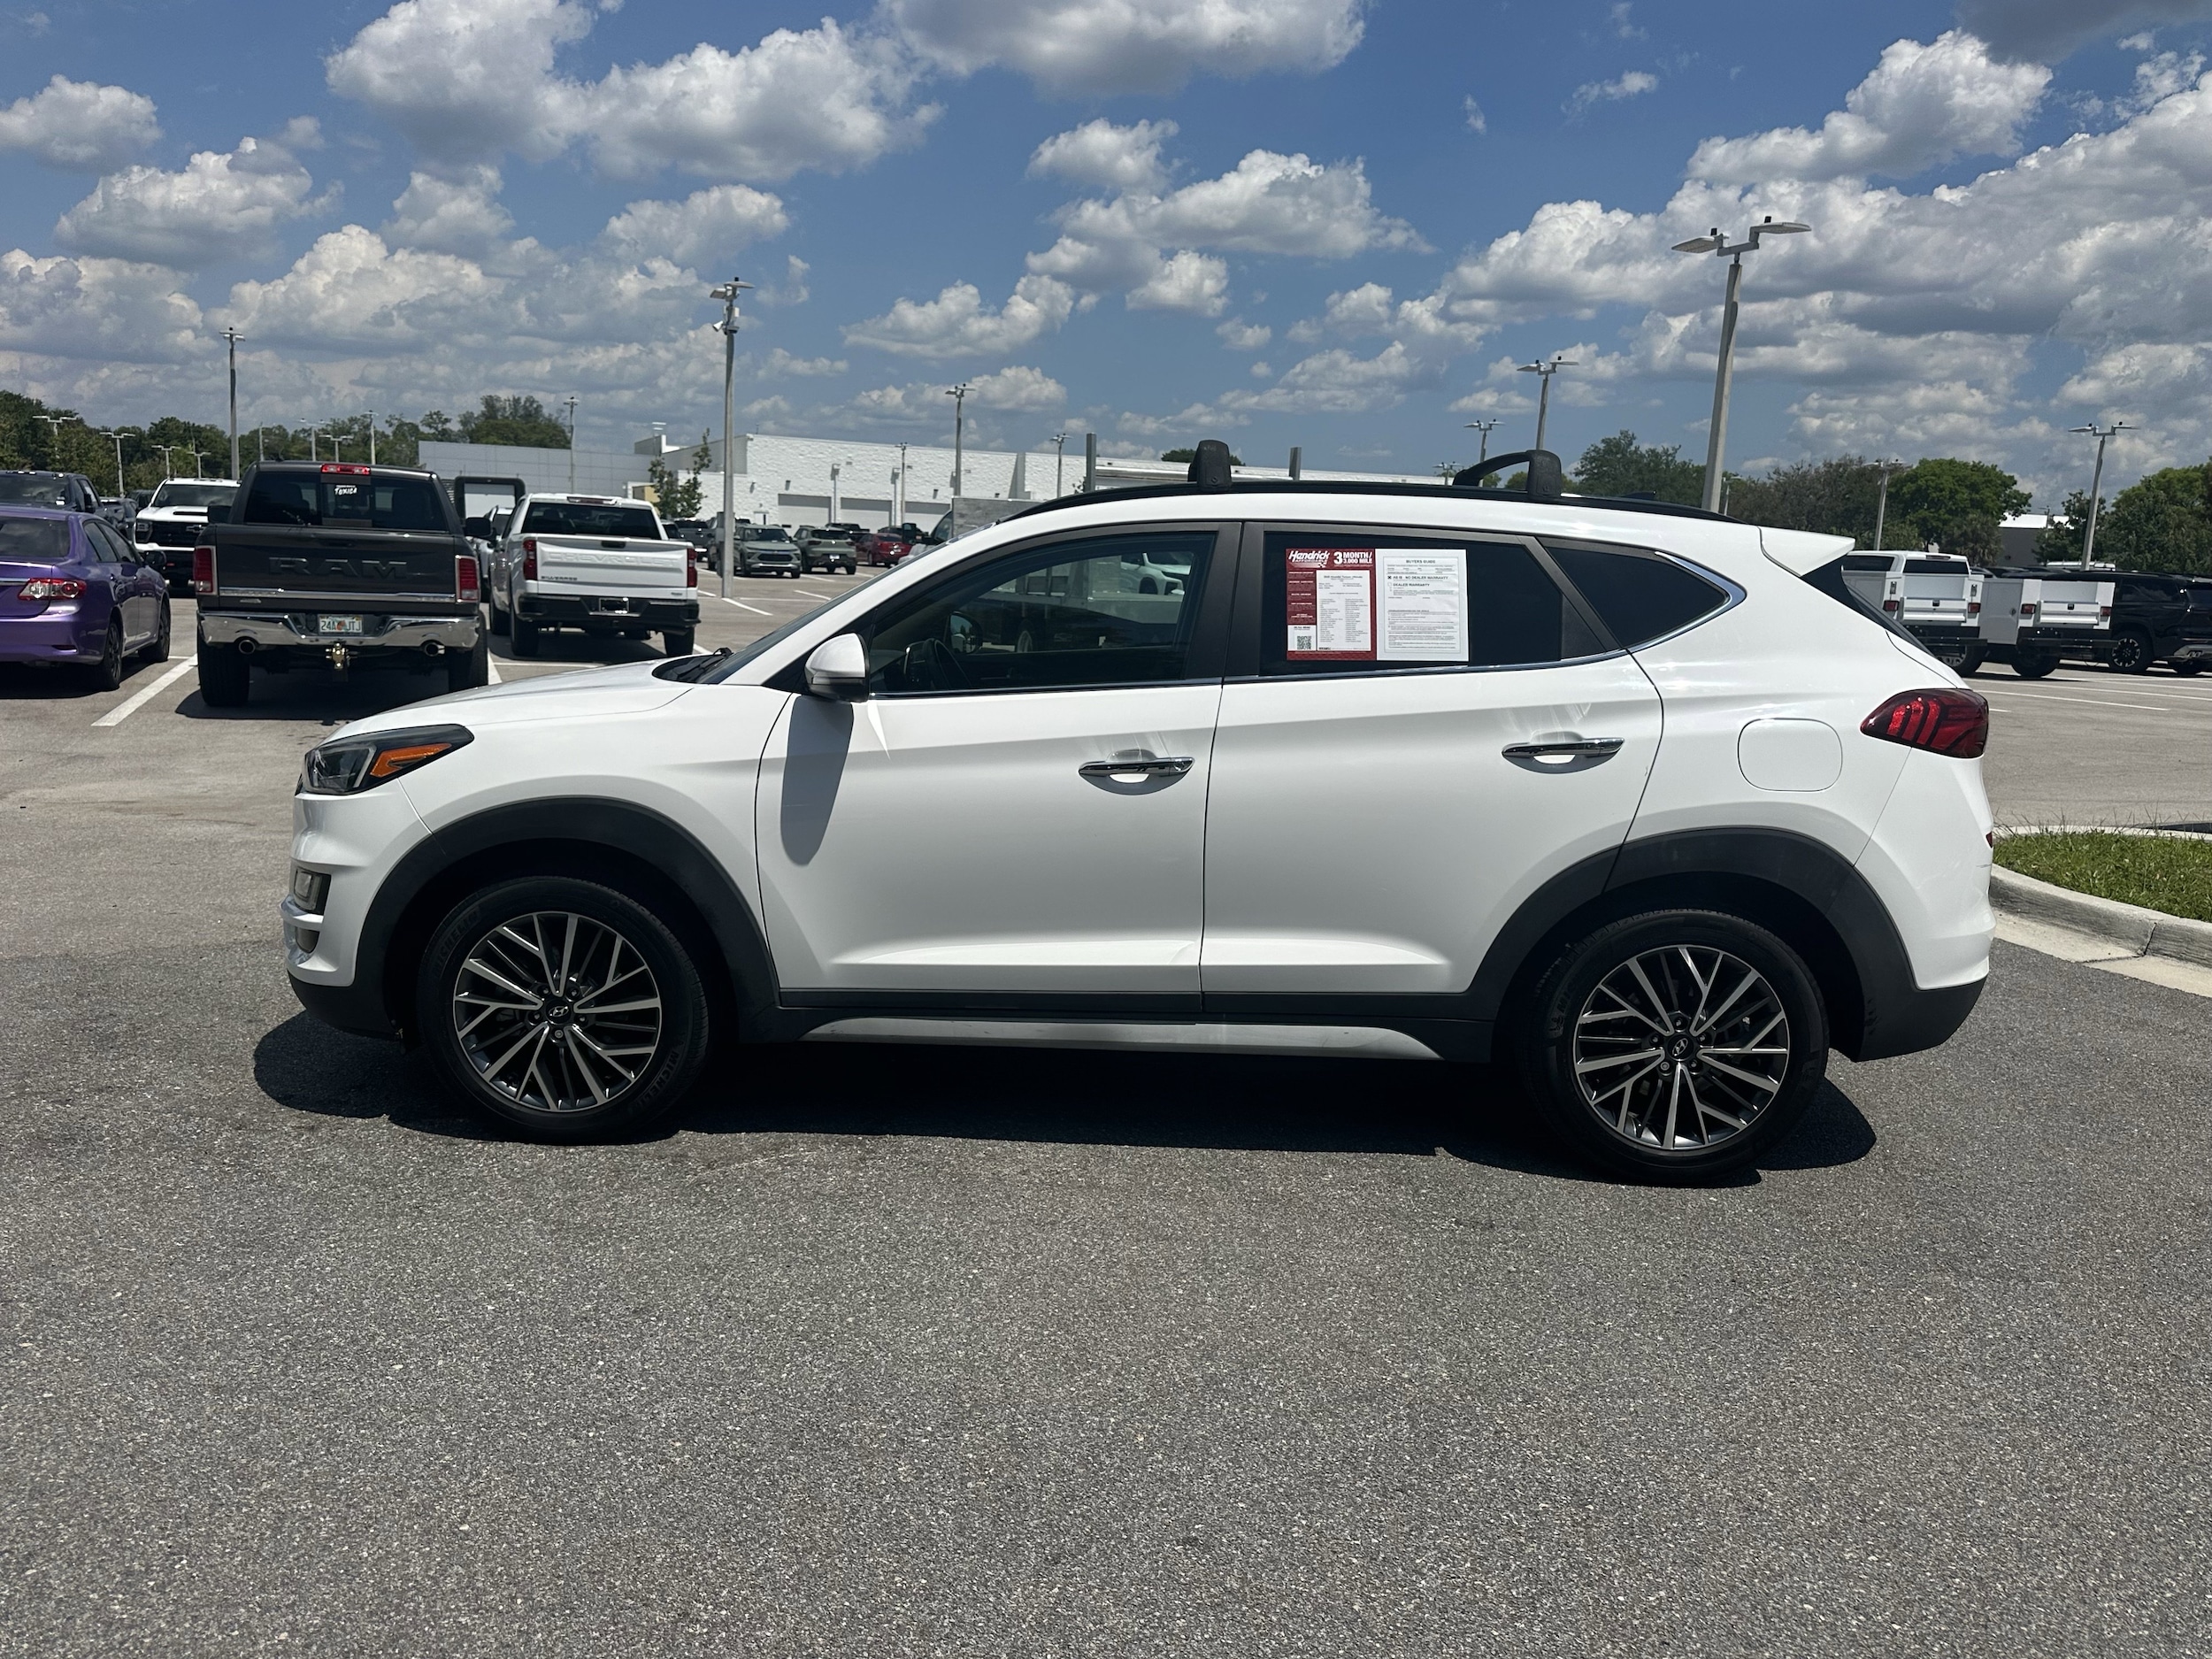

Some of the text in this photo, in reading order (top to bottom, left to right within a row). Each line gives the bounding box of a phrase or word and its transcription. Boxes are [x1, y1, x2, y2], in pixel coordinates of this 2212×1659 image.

[549, 551, 680, 567] CHEVROLET
[1288, 550, 1330, 562] Hendrick
[1333, 551, 1342, 565] 3
[268, 557, 408, 579] RAM
